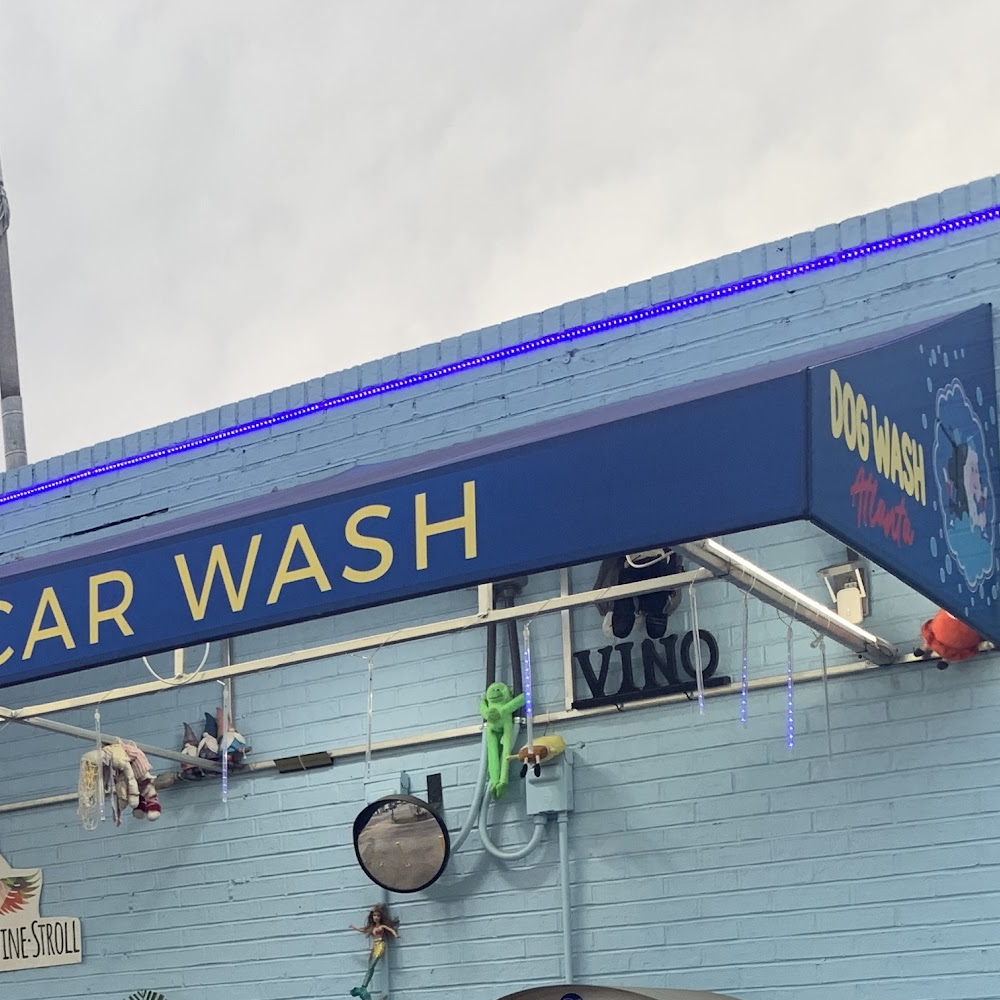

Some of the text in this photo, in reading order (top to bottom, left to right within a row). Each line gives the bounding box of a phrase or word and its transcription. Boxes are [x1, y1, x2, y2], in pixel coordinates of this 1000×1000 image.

[830, 369, 926, 506] DOG WASH
[175, 480, 478, 621] WASH
[850, 467, 914, 547] Atlanta
[573, 629, 719, 700] VINO
